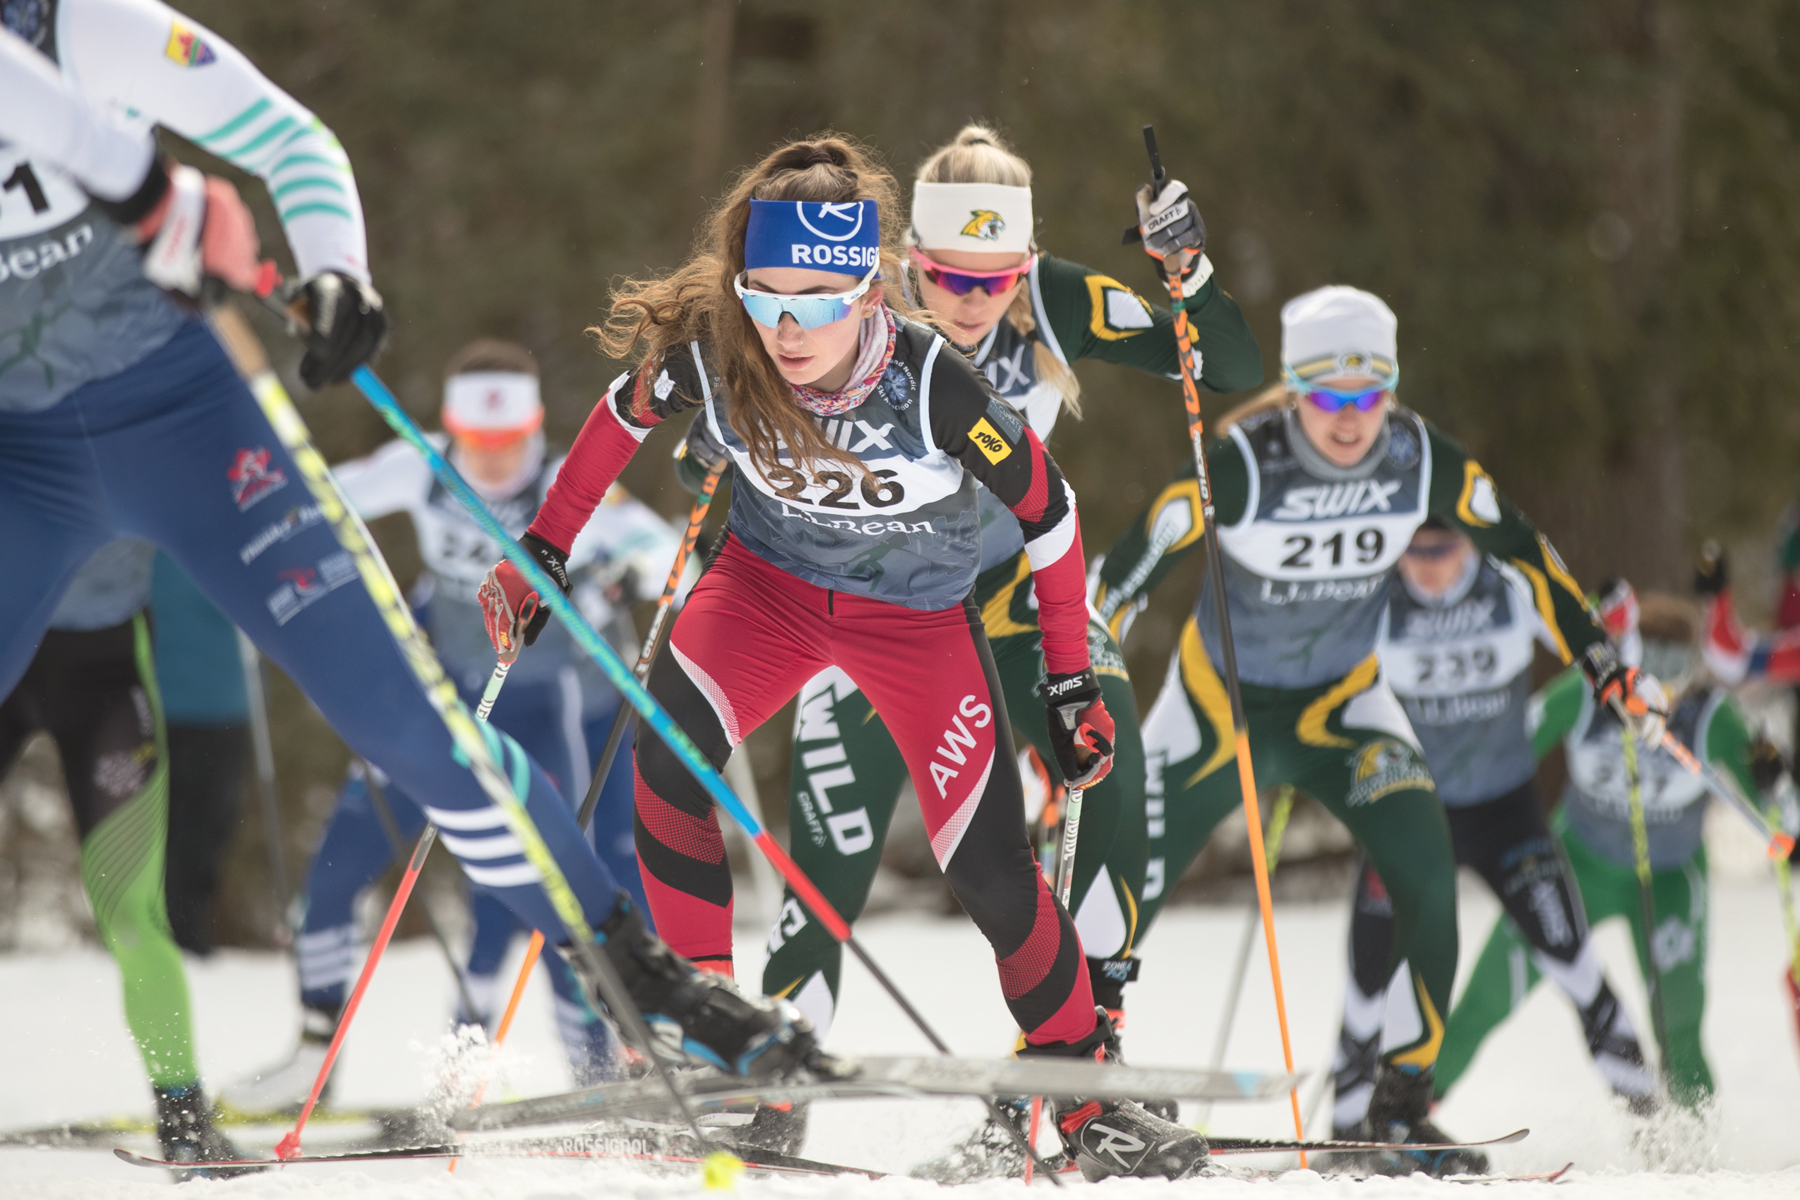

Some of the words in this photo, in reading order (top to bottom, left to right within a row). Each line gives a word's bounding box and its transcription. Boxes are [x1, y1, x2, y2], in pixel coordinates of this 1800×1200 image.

[0, 222, 94, 281] ean
[791, 244, 879, 267] ROSSIG
[974, 431, 1003, 453] TOKO
[767, 469, 905, 510] 226
[1271, 479, 1402, 520] SWIX
[1280, 529, 1385, 567] 219
[929, 694, 991, 800] AWS
[800, 689, 875, 856] WILD
